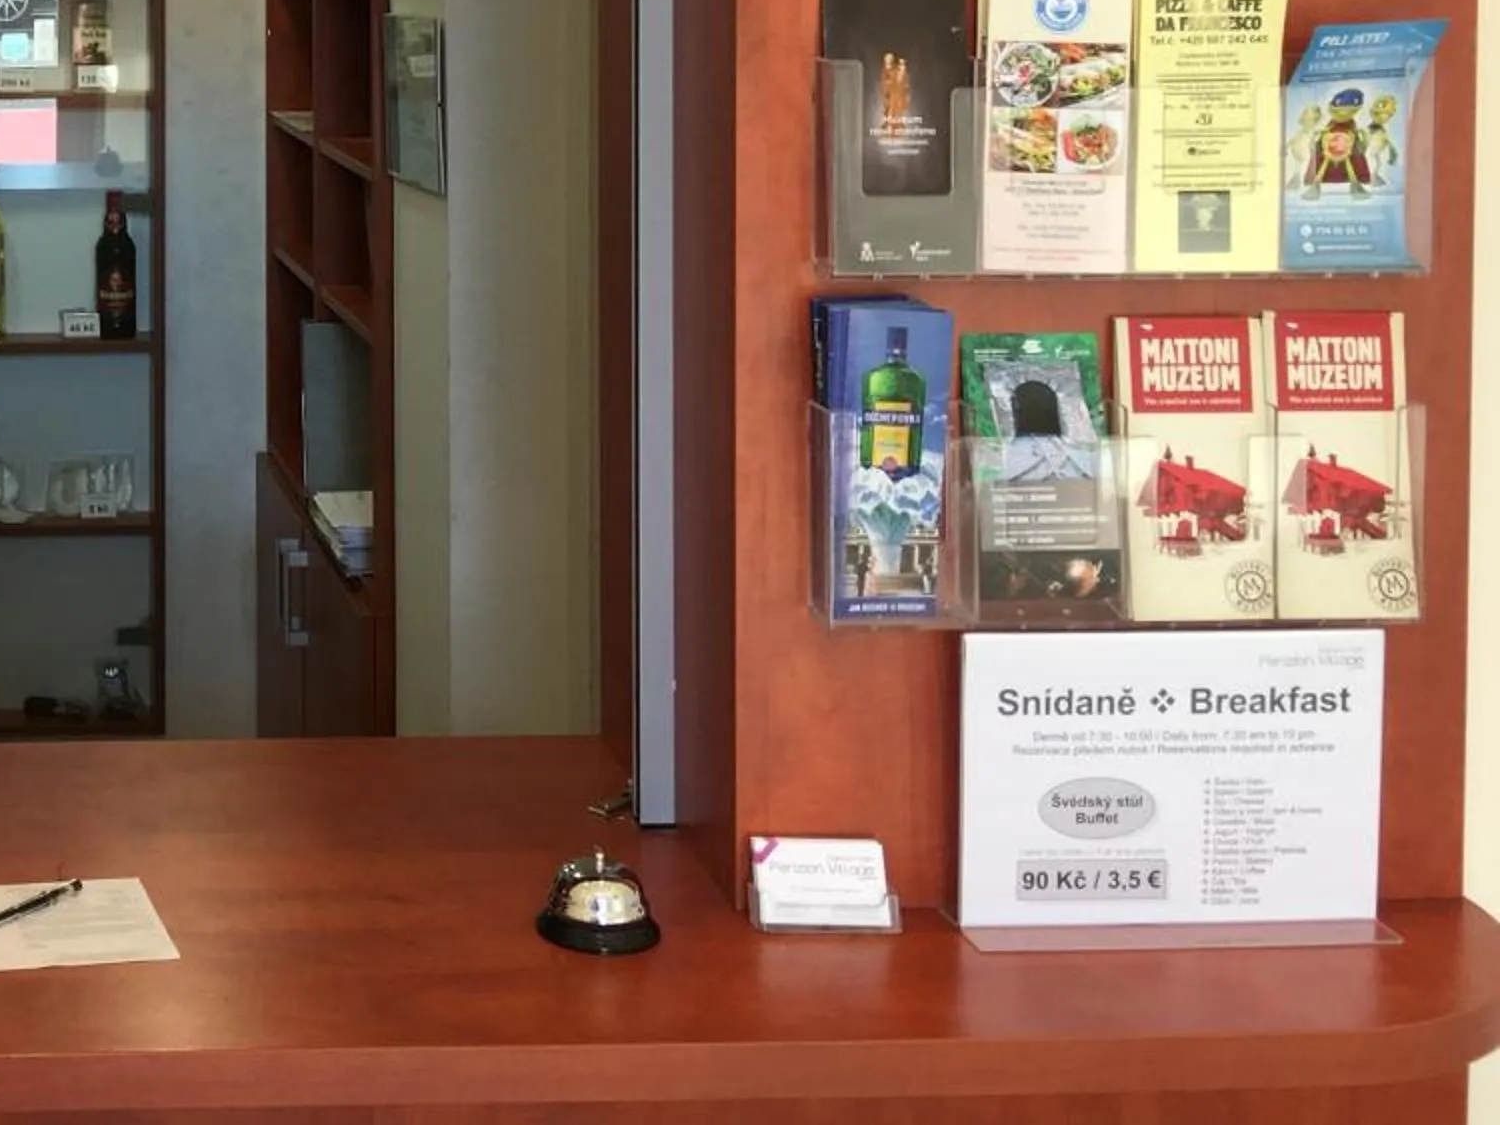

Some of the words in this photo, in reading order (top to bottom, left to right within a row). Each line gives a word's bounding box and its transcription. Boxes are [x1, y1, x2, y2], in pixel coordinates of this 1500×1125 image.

[1155, 15, 1175, 31] DA
[1140, 338, 1239, 364] MATTONI
[1286, 336, 1382, 363] MATTONI
[1142, 365, 1241, 392] MUZEUM
[1287, 364, 1383, 390] MUZEUM
[997, 687, 1136, 717] Snídaně
[1190, 686, 1352, 715] Breakfast
[1075, 812, 1120, 825] Buffet
[1021, 871, 1050, 891] 90
[1056, 870, 1088, 890] Kč
[1107, 870, 1142, 891] 3,5
[1147, 869, 1163, 889] €
